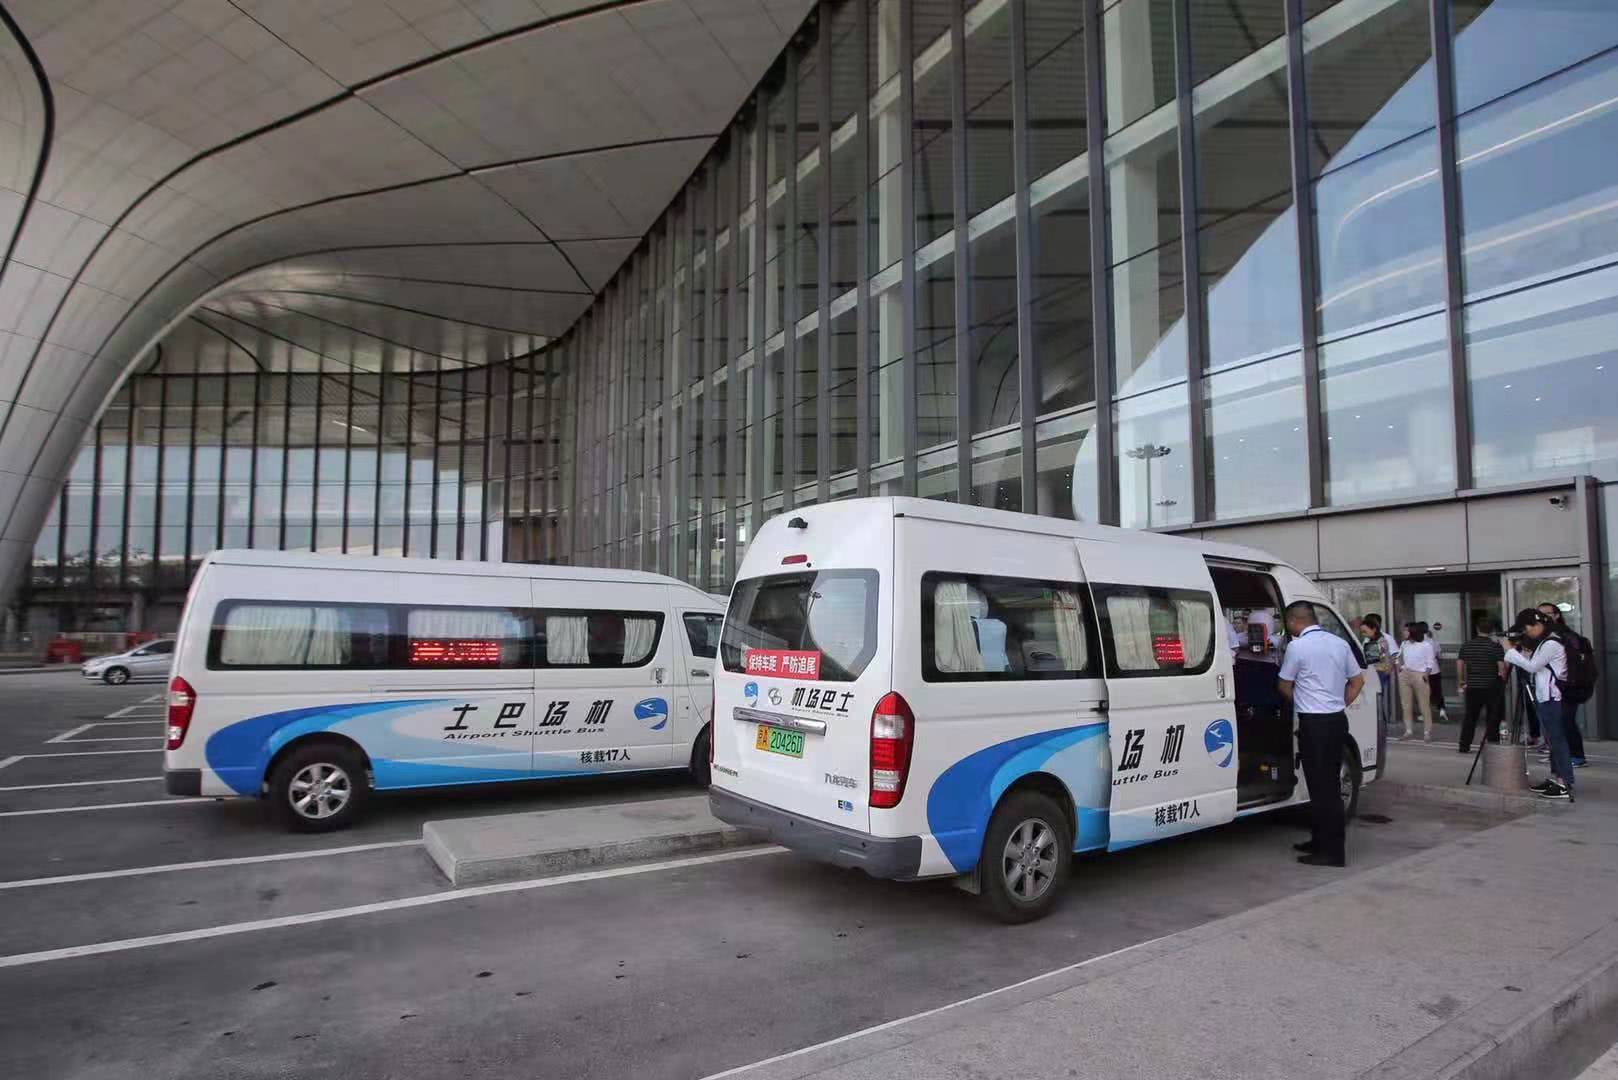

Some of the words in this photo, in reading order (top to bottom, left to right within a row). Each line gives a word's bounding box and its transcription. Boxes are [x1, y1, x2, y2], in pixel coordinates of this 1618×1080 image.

[749, 654, 777, 671] 保持车距
[781, 655, 815, 675] 严防追尾
[792, 687, 854, 712] 机场巴士
[443, 732, 506, 740] Airport
[511, 728, 571, 737] Shuttle
[580, 749, 631, 764] 核载17人
[1112, 773, 1148, 786] uttle
[1153, 769, 1179, 779] Bus
[1154, 799, 1200, 827] 核载17人
